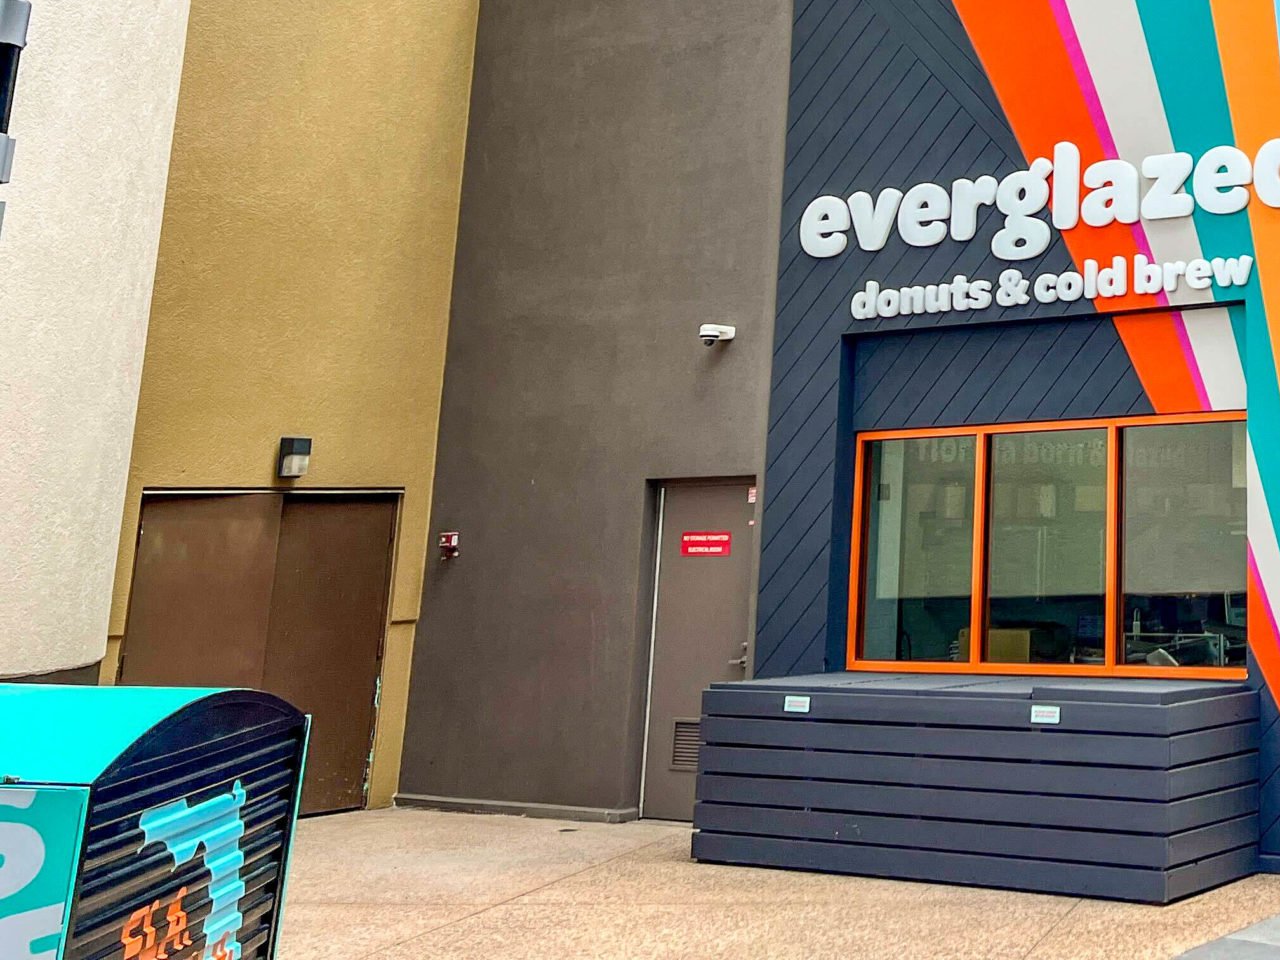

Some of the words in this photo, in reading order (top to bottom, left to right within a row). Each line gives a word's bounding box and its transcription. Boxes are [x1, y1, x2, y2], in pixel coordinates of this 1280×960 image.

[850, 273, 993, 320] donuts
[997, 268, 1031, 308] &
[1033, 255, 1127, 303] cold
[1132, 253, 1254, 296] brew
